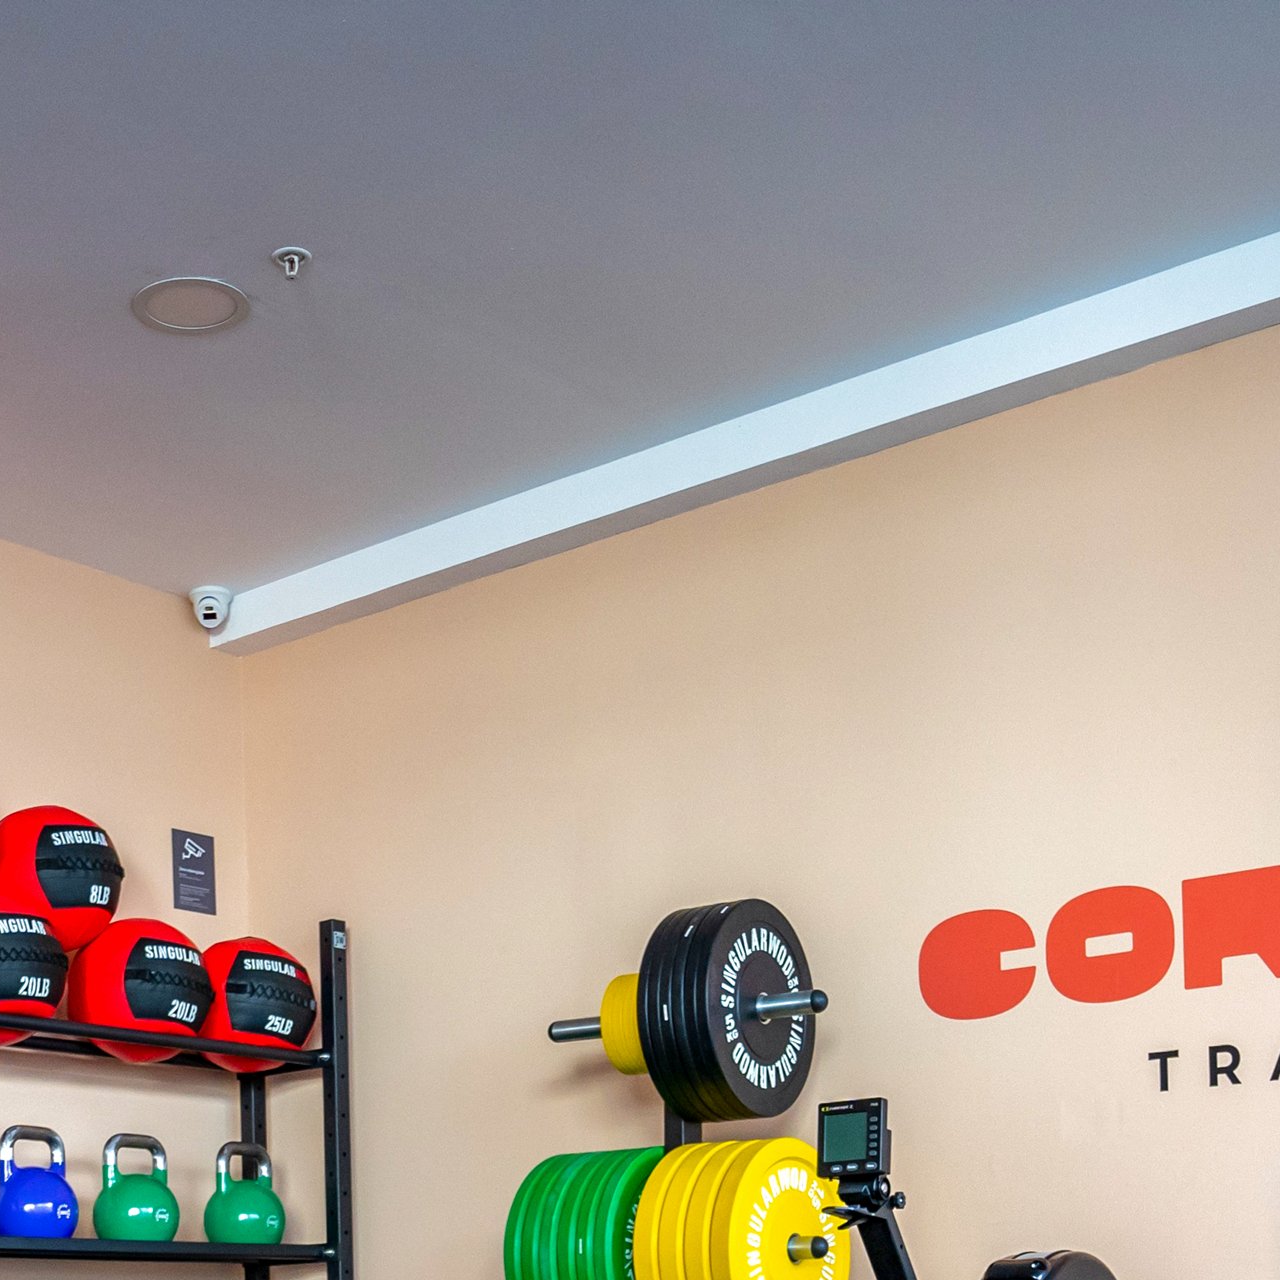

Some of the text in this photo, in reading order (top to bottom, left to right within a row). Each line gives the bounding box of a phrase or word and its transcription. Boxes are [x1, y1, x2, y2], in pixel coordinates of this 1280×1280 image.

[89, 884, 111, 905] 8LB
[18, 976, 50, 997] 20LB
[168, 1000, 198, 1023] 20LB
[265, 1015, 293, 1035] 25LB
[725, 1013, 739, 1043] 5 KG
